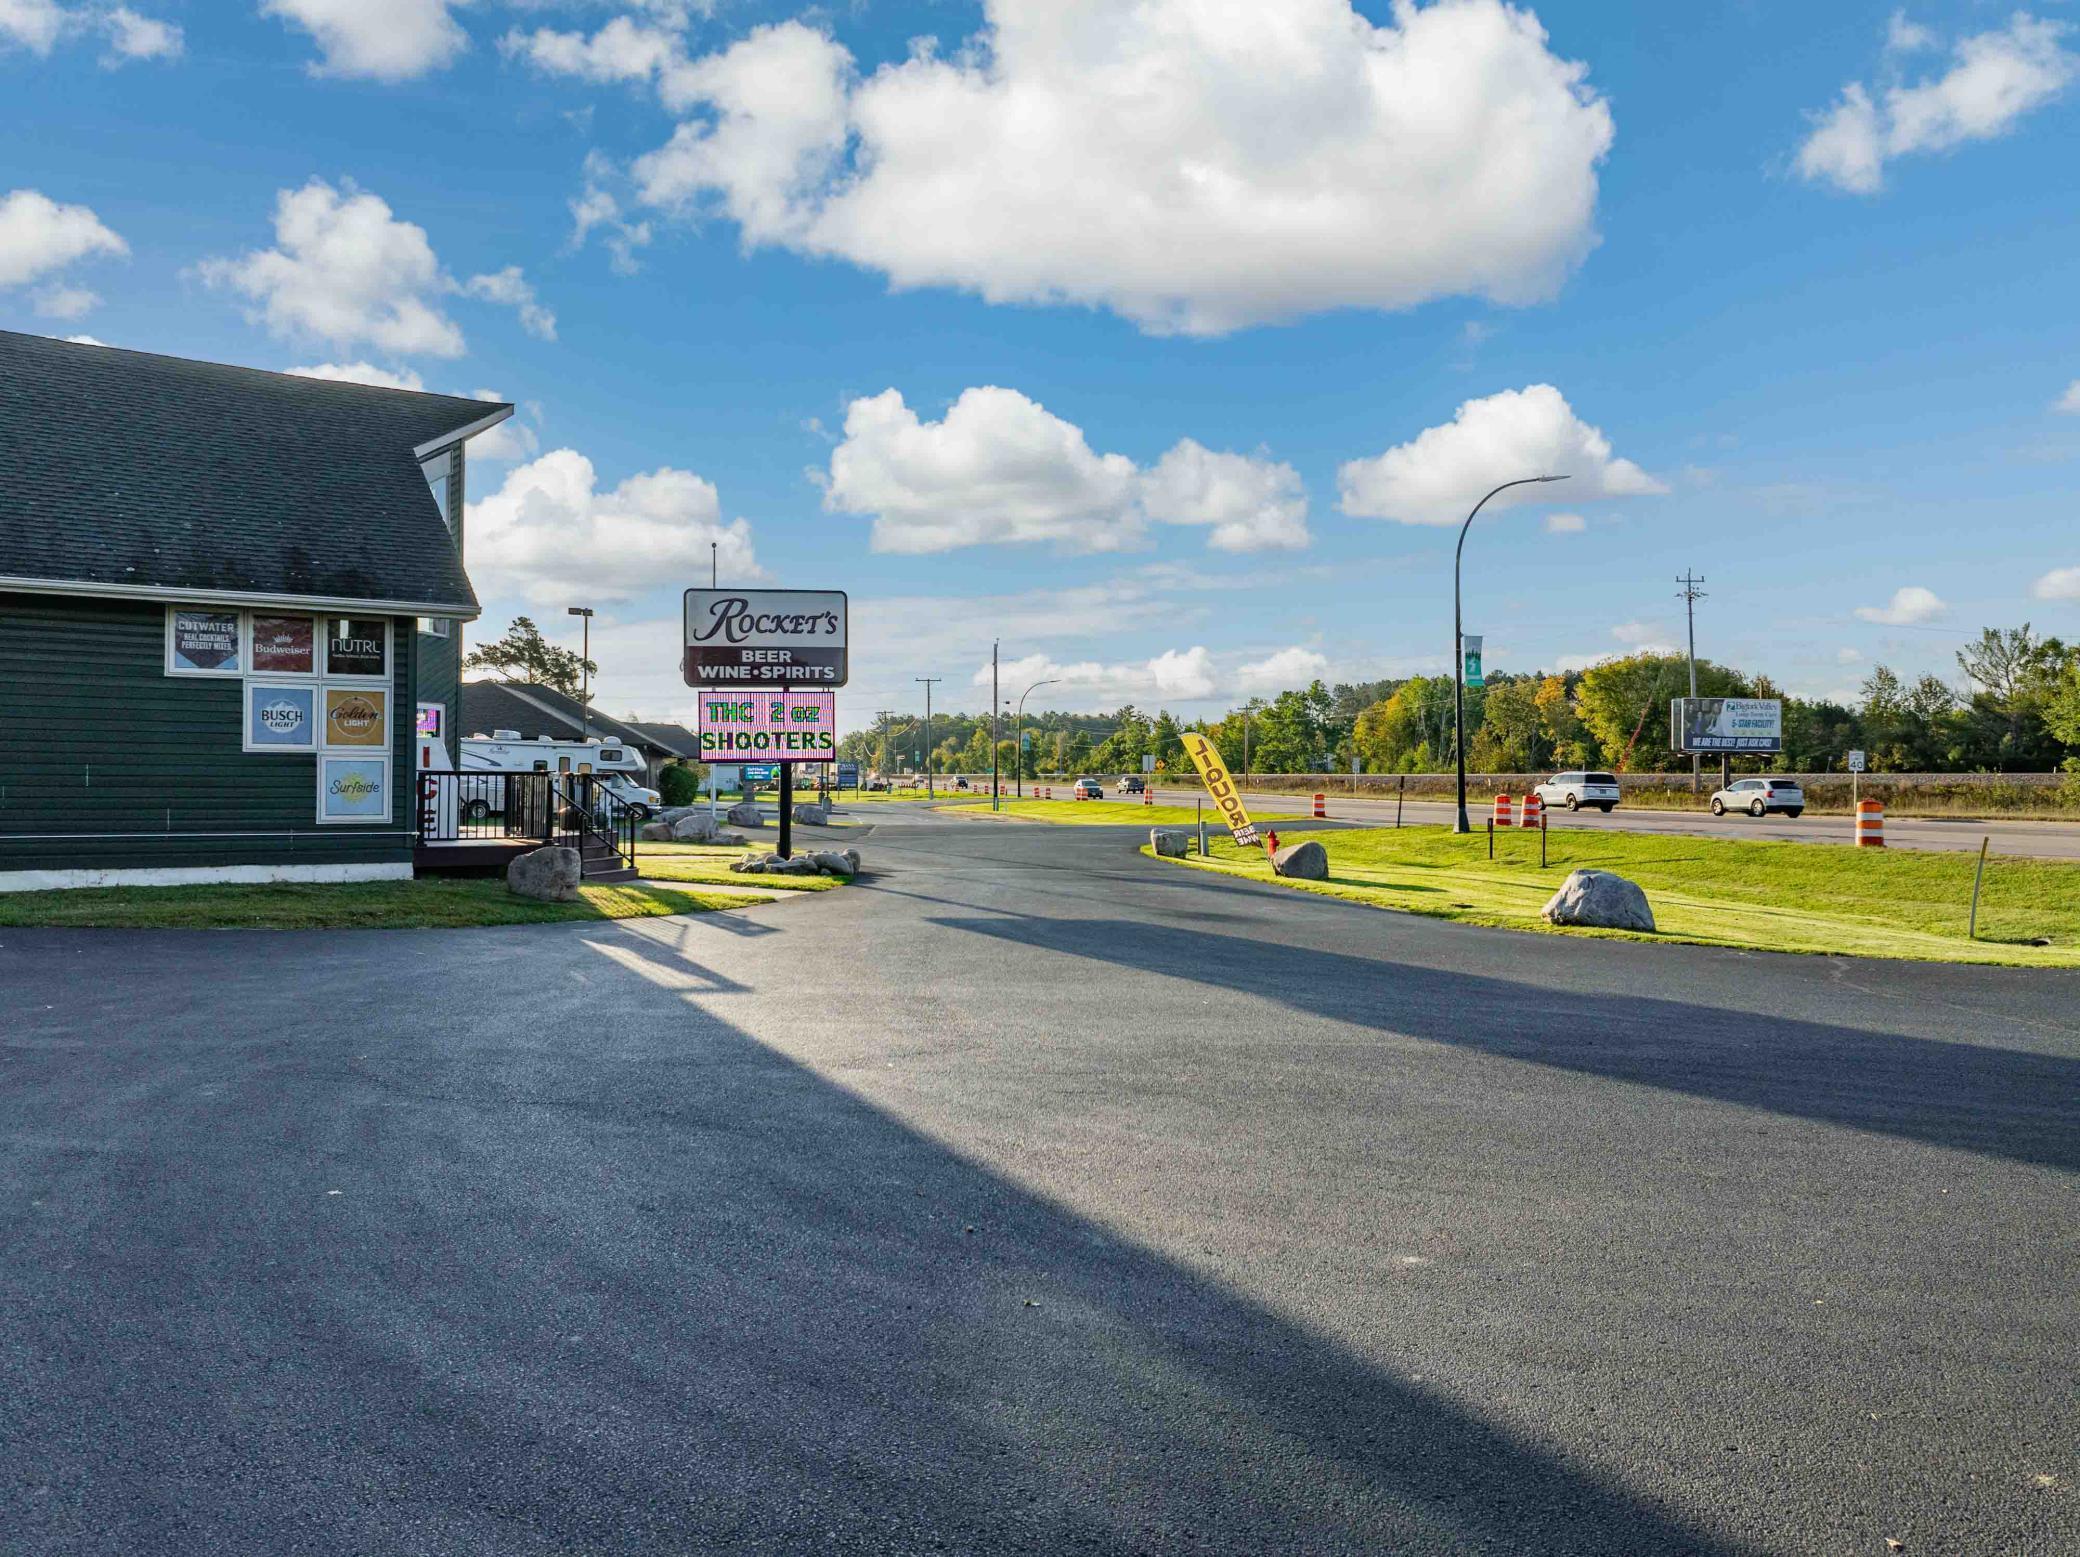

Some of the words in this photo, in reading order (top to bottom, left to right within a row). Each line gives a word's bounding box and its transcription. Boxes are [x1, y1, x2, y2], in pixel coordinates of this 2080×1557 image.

[178, 620, 234, 632] CUTWATER
[183, 632, 198, 641] REAL
[181, 640, 212, 650] PERFECTLY
[254, 643, 312, 655] Budweiser
[741, 649, 792, 663] BEER
[261, 709, 303, 722] BUSCH
[329, 706, 379, 720] Golden
[706, 701, 754, 723] THC
[770, 701, 785, 723] 2
[343, 719, 370, 727] LIGHT
[701, 731, 833, 750] SHOOTERS
[1850, 761, 1863, 769] 40
[329, 779, 380, 795] Surfside
